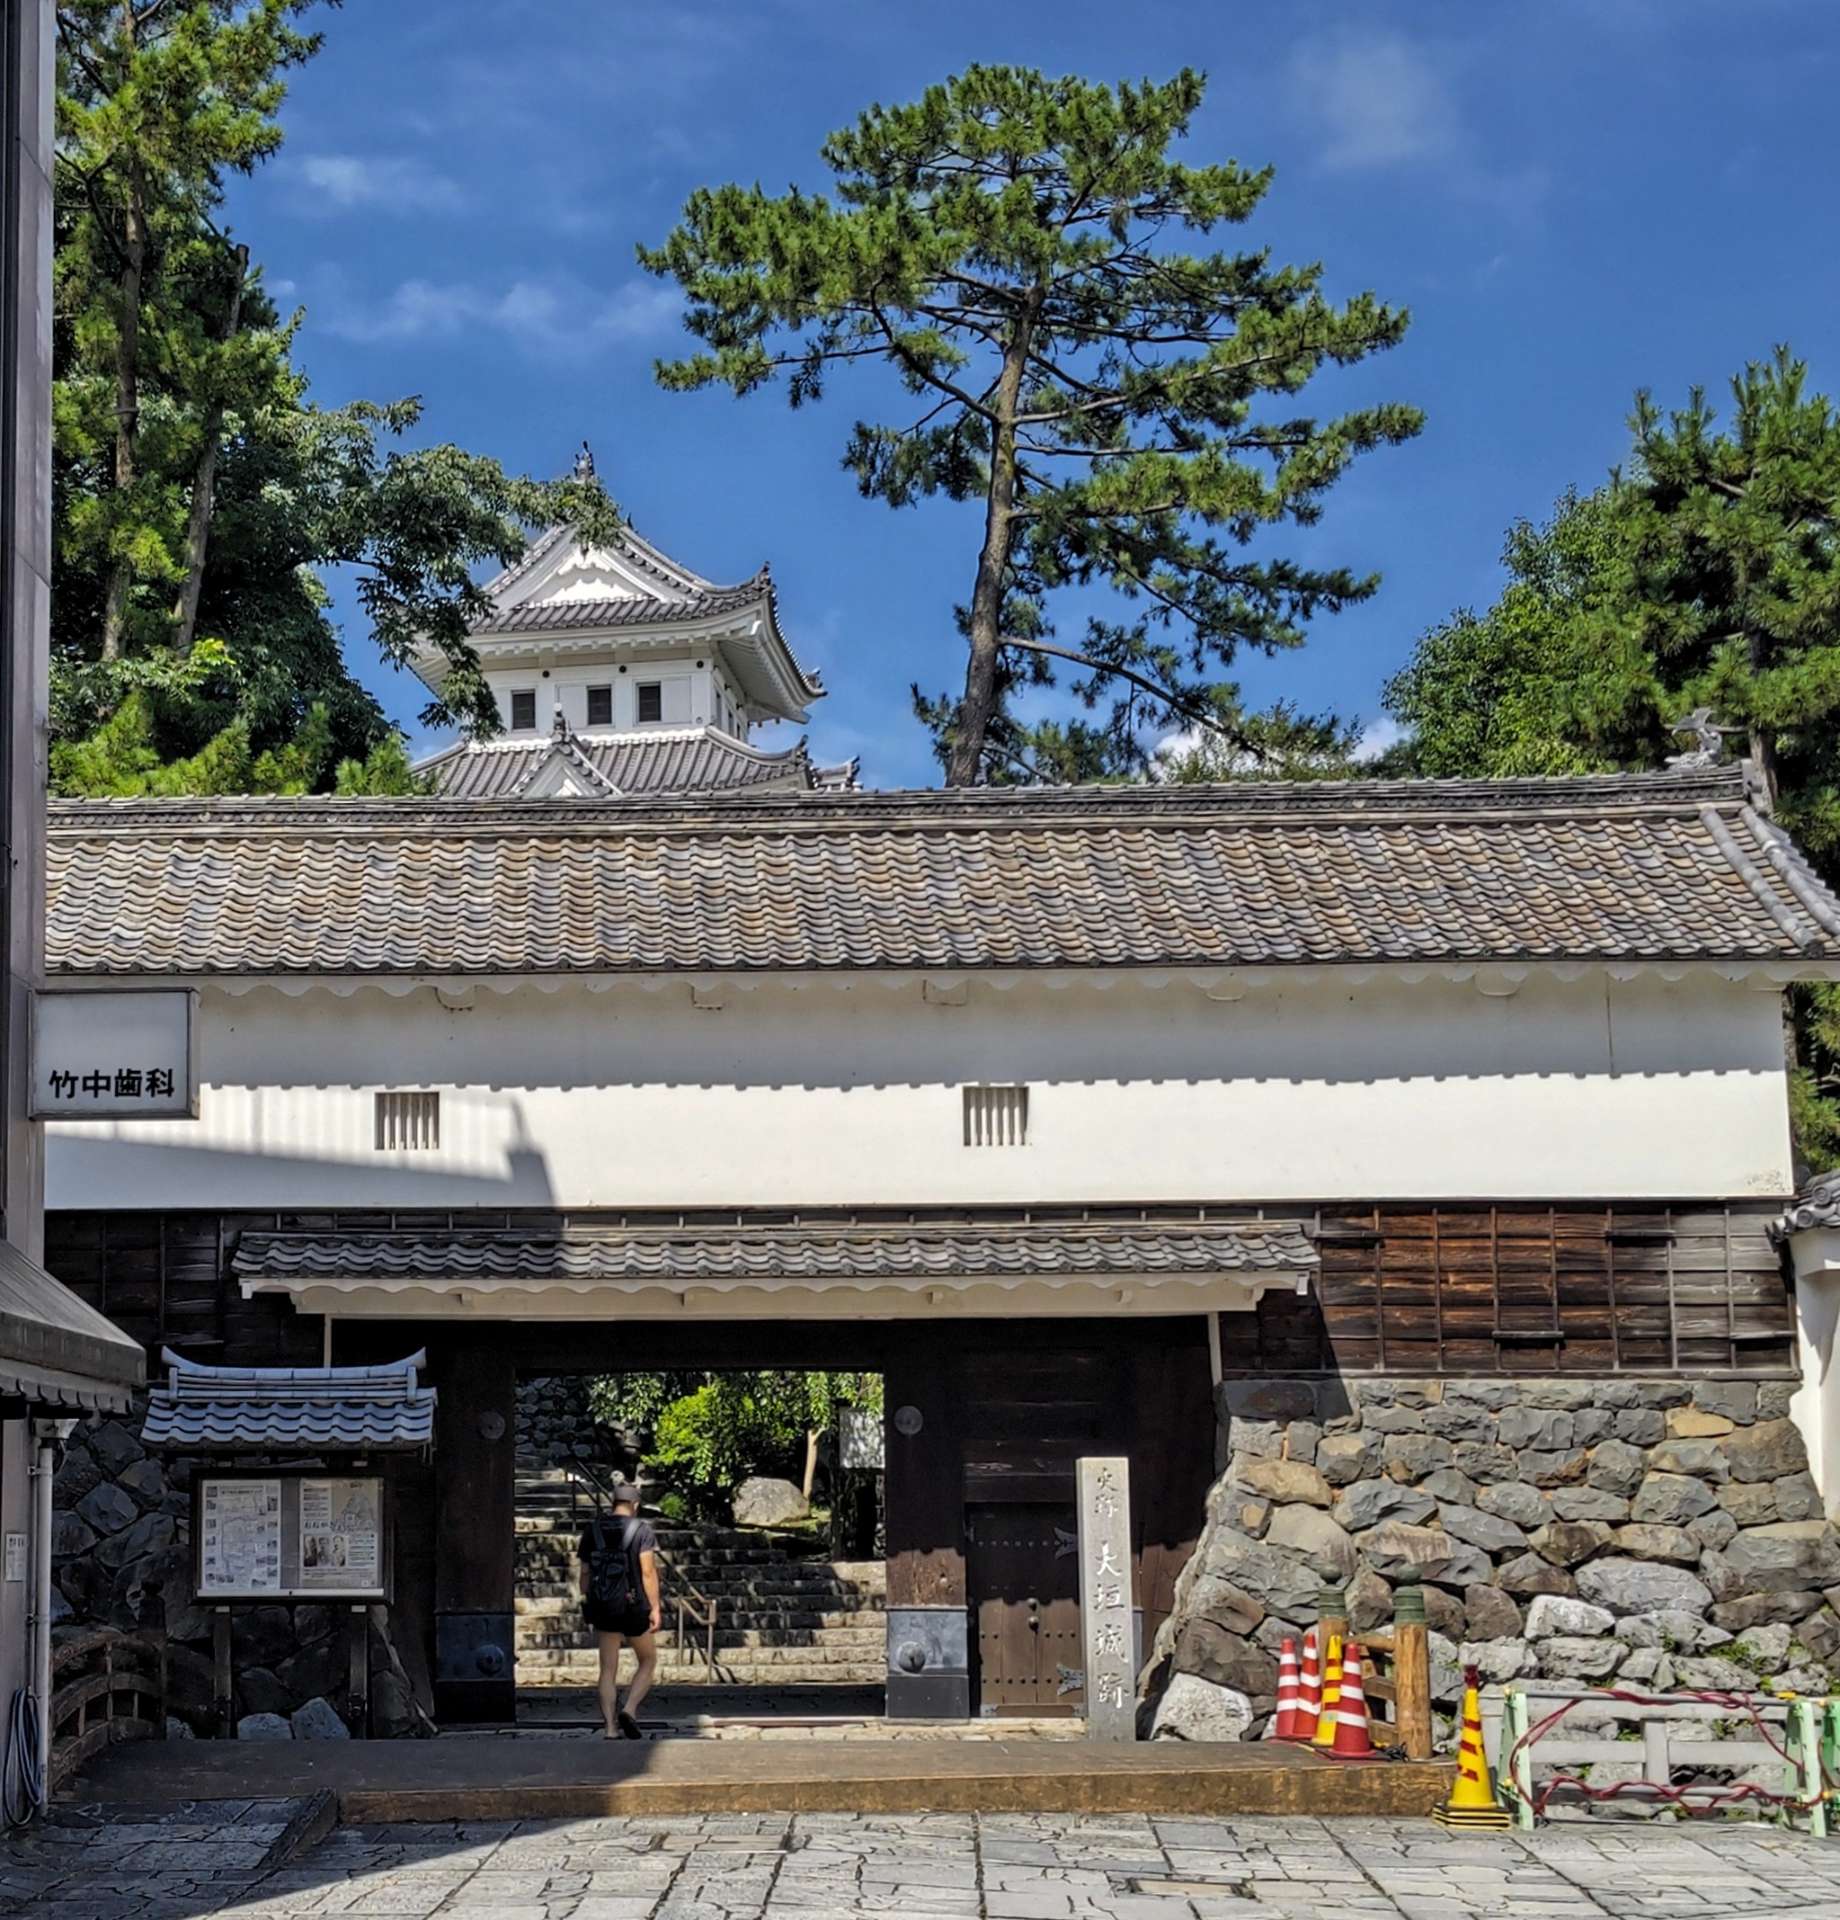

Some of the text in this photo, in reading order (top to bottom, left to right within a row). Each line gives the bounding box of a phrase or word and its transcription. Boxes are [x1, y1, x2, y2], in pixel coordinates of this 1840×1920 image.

[49, 1068, 174, 1099] 竹中歯科
[1094, 1540, 1130, 1709] 大垣城跡
